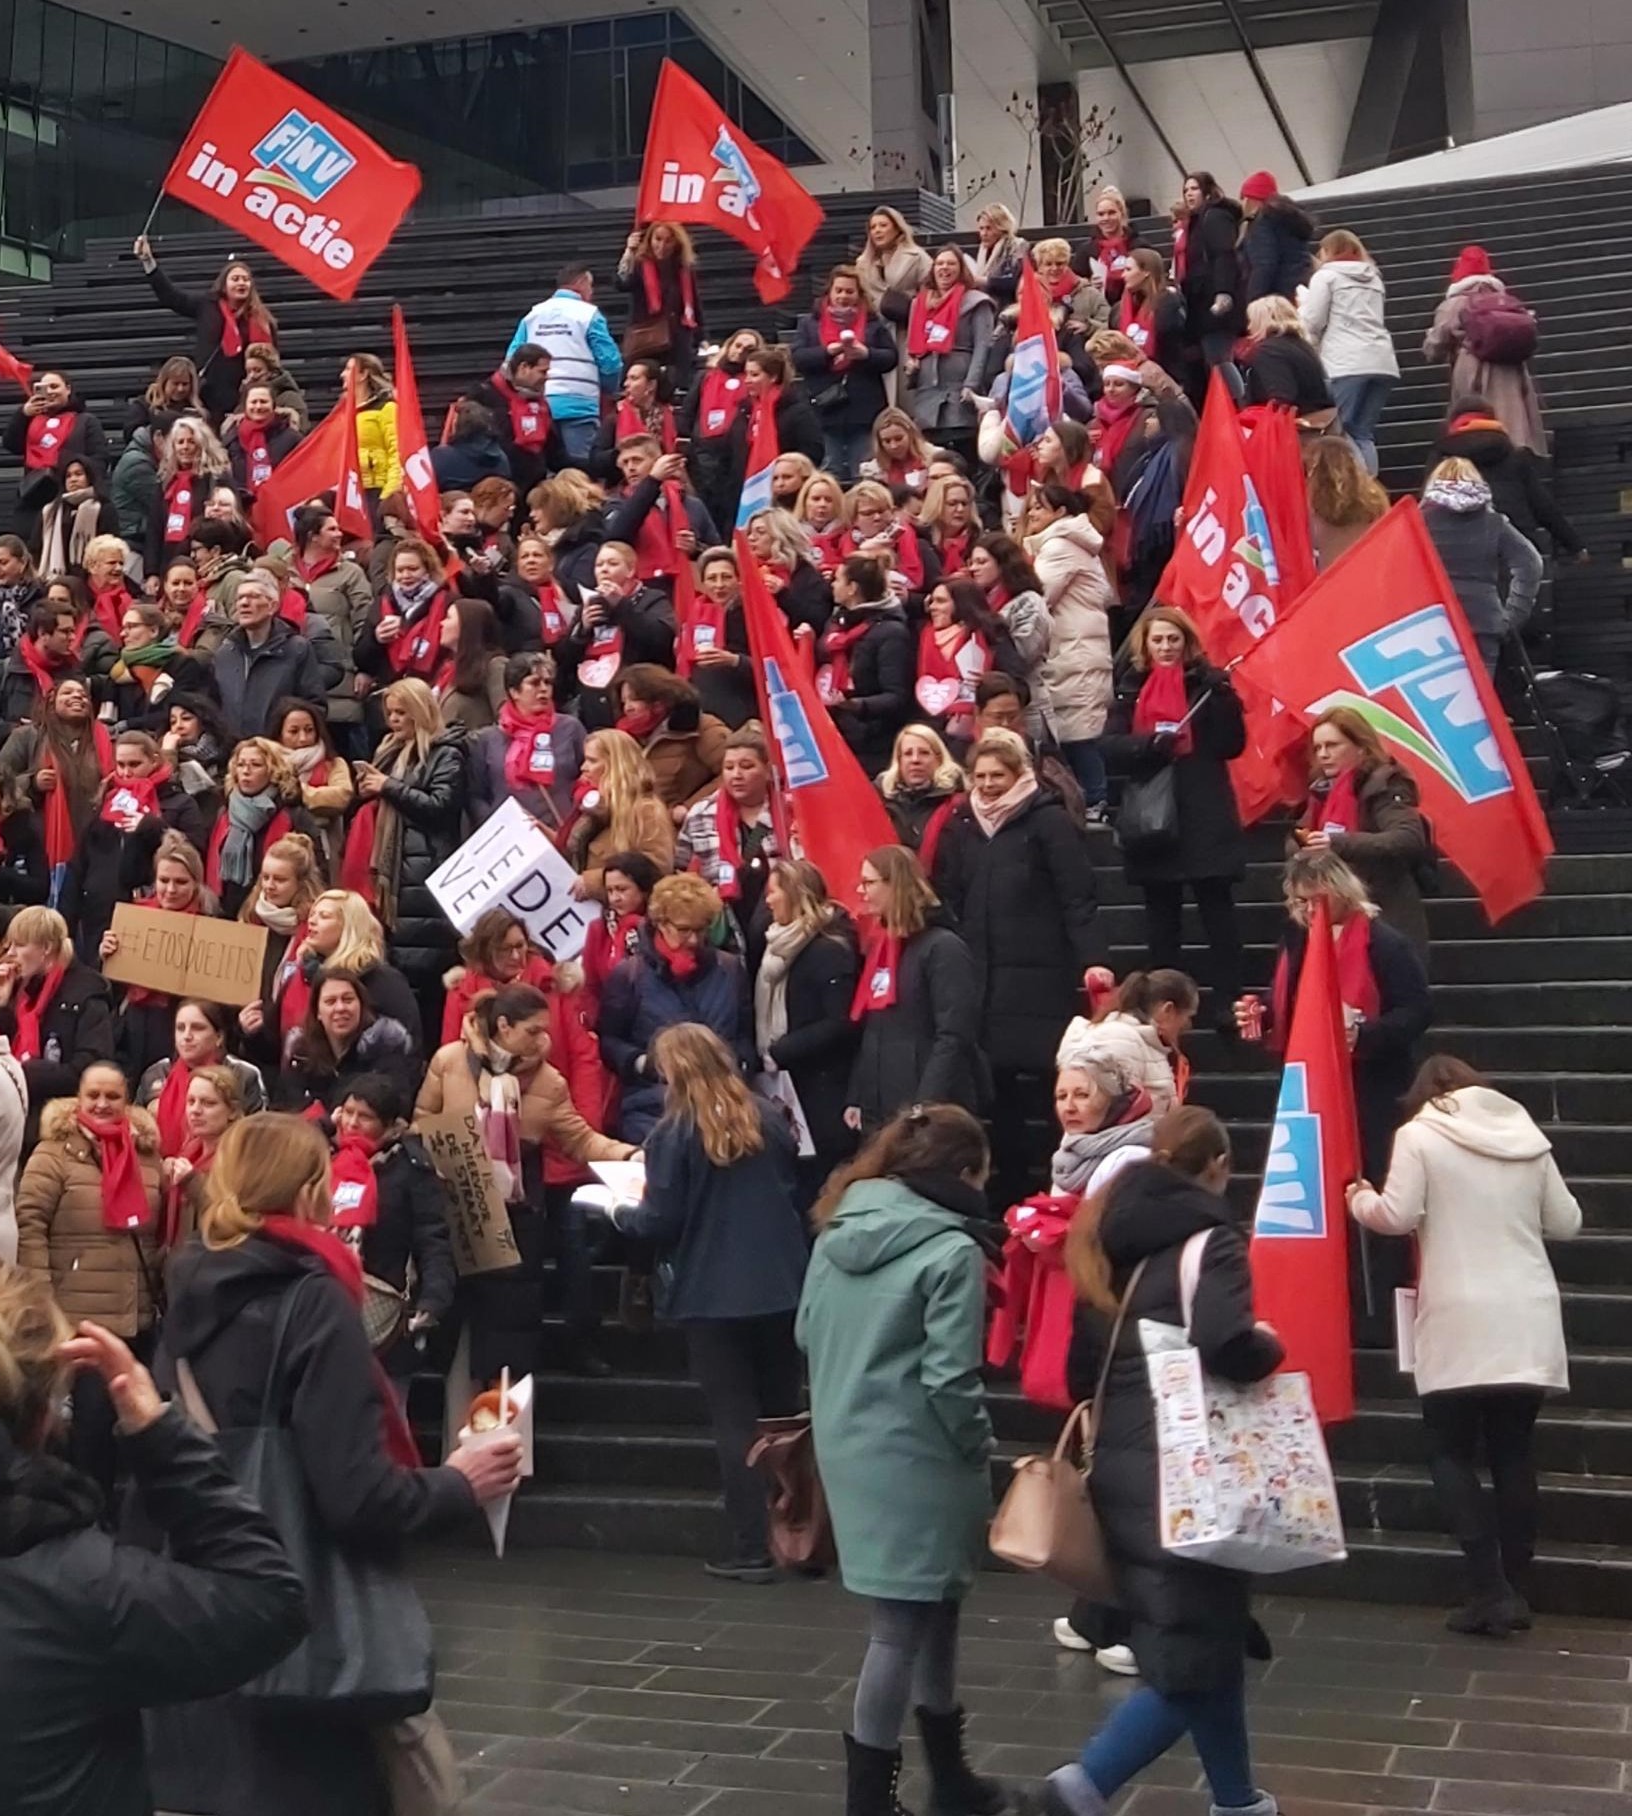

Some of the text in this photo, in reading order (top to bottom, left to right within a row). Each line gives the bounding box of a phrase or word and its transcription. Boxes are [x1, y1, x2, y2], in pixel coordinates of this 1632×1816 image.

[263, 123, 350, 184] FNV
[660, 161, 706, 204] in
[186, 142, 354, 269] in actie
[1186, 486, 1226, 566] in
